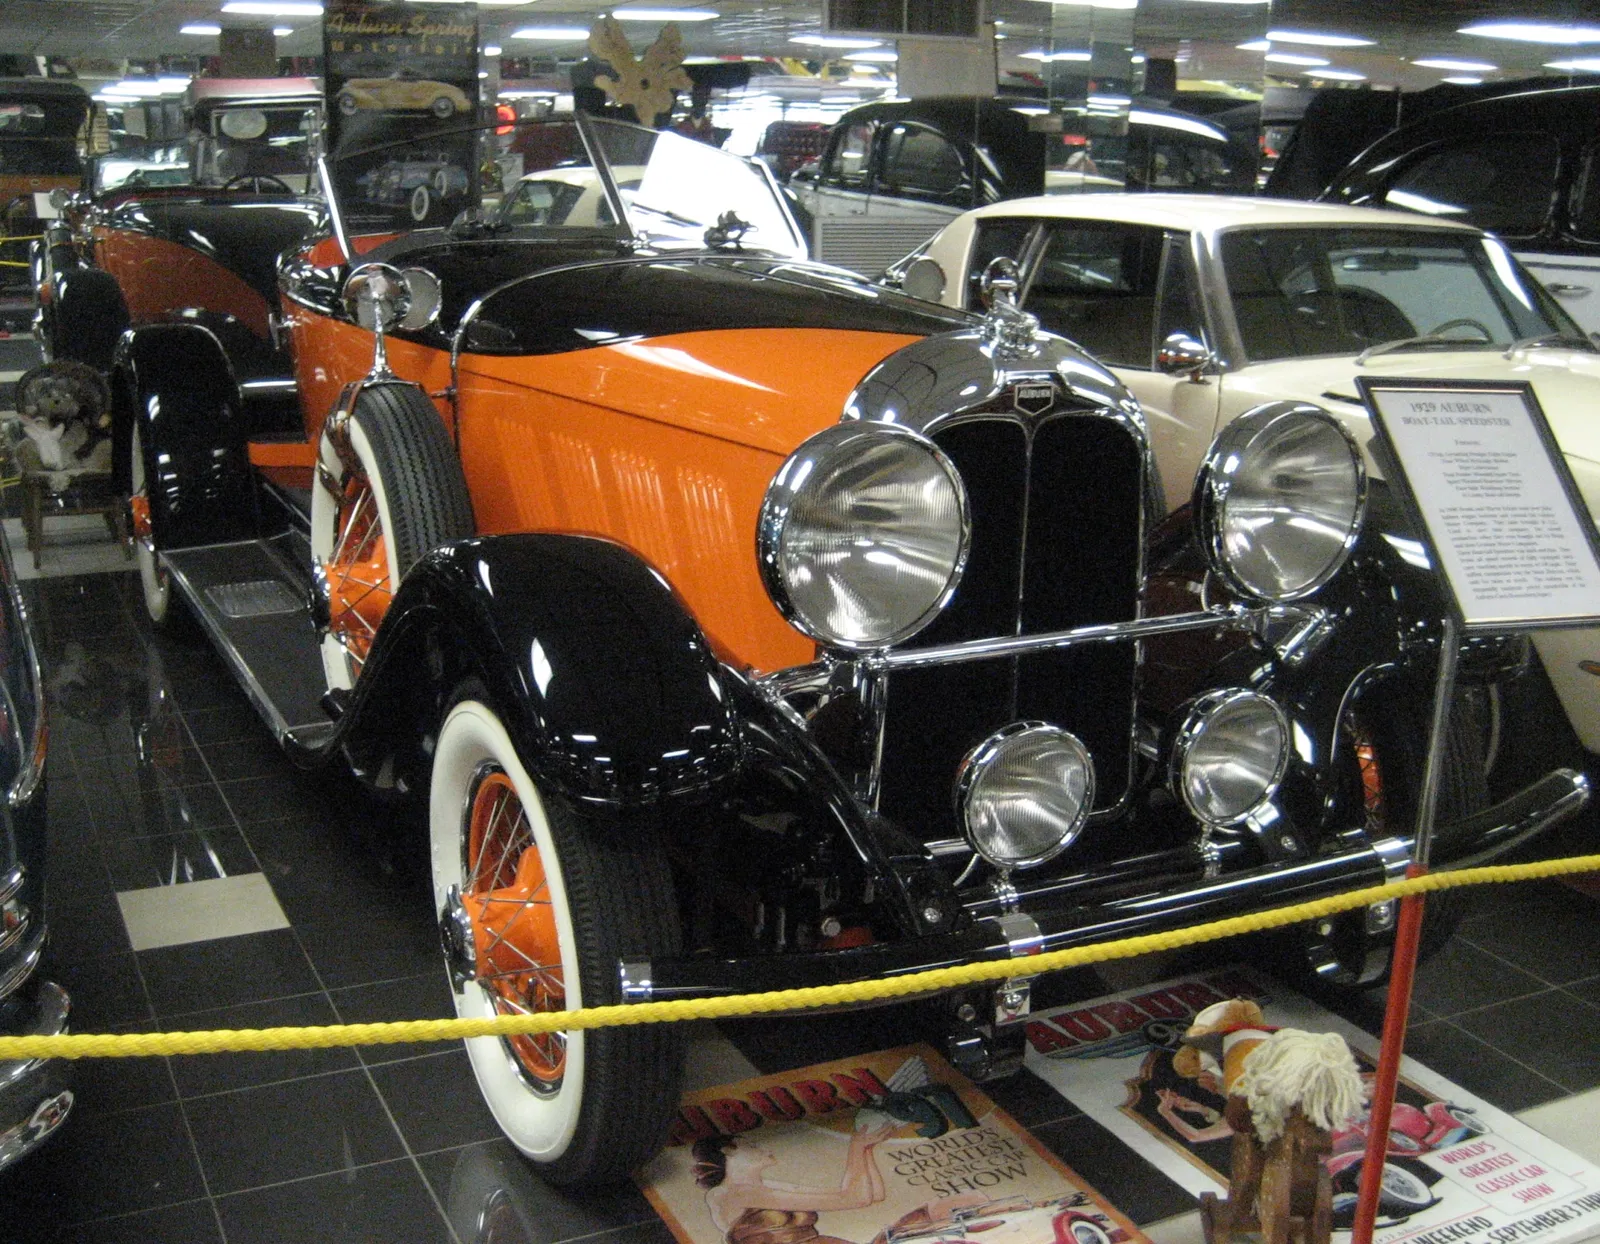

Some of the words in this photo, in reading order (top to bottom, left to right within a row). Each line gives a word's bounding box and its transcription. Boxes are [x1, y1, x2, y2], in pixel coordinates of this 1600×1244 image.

[326, 13, 402, 34] Auburn
[406, 14, 475, 43] Spring
[1402, 416, 1457, 426] BOAT-TAIL
[1459, 417, 1512, 427] SPEEDSTER
[1410, 402, 1437, 413] 1929
[1440, 403, 1492, 414] AUBURN
[887, 1127, 1000, 1162] WORLD'S
[894, 1137, 1018, 1176] GREATEST
[1439, 1141, 1496, 1164] WORLD'S
[907, 1161, 985, 1187] CLASSIC
[988, 1150, 1030, 1167] CAR
[1458, 1152, 1519, 1178] GREATEST
[1475, 1172, 1526, 1194] CLASSIC
[1518, 1164, 1548, 1179] CAR
[931, 1163, 1027, 1199] SHOW
[1512, 1183, 1556, 1204] SHOW
[1411, 1215, 1493, 1244] WEEKEND
[1487, 1208, 1574, 1244] SEPTEMBER
